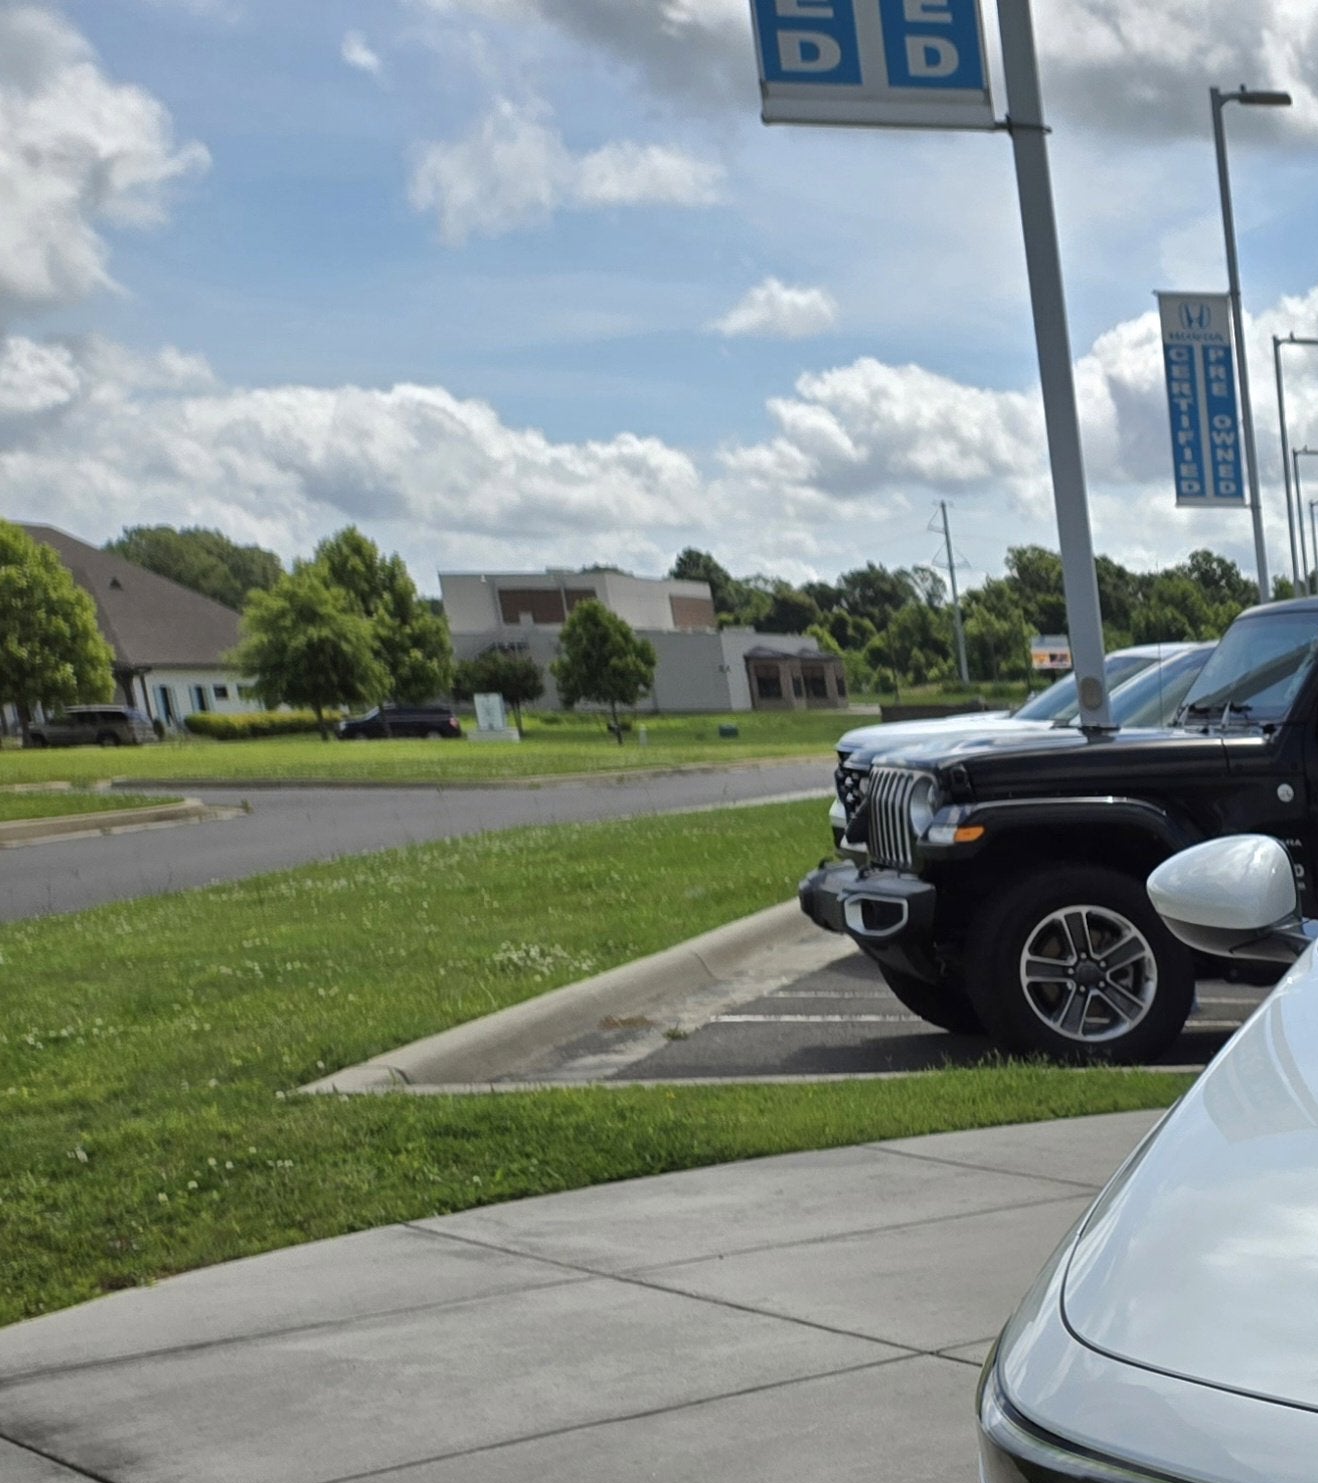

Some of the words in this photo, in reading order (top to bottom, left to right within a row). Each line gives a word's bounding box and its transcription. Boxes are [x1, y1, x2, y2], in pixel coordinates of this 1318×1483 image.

[1209, 349, 1226, 396] PRE
[1169, 348, 1200, 495] CERTIFIED
[1213, 415, 1236, 494] OWNED
